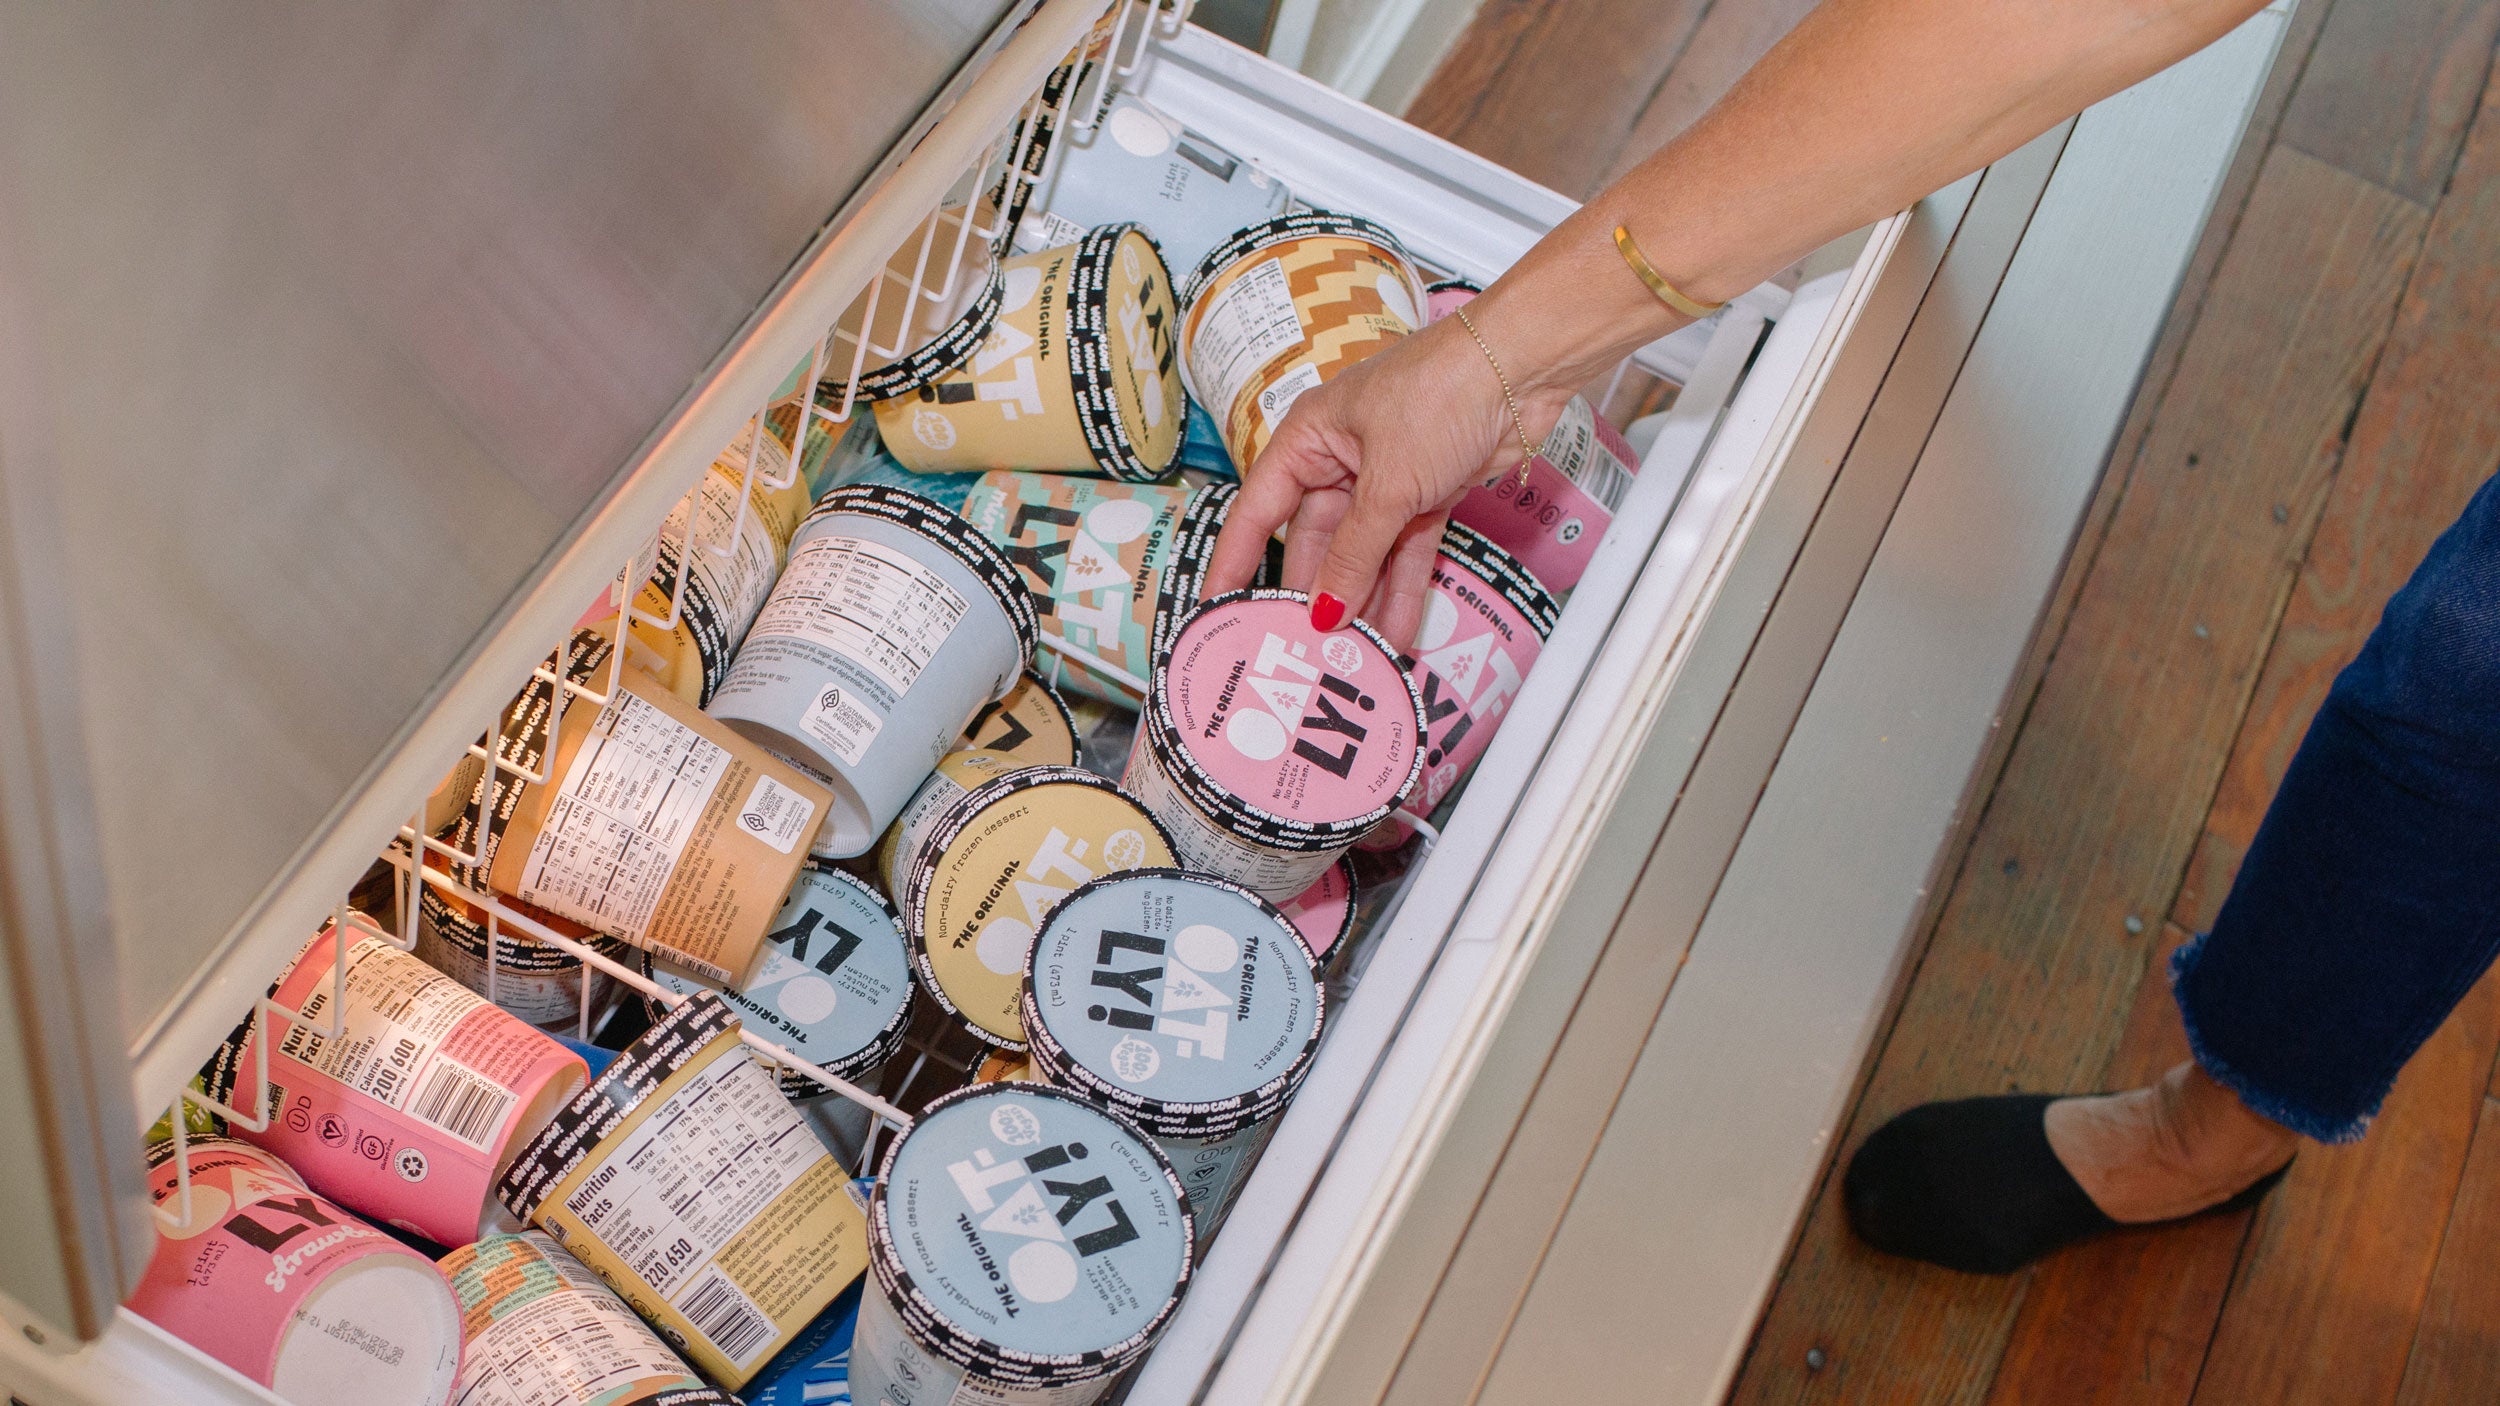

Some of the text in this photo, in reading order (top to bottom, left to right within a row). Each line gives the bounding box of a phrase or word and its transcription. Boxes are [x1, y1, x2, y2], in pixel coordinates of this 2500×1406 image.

[1164, 162, 1180, 196] pint
[1038, 257, 1064, 362] THE ORIGINAL
[1565, 426, 1586, 477] 200 600
[885, 492, 952, 525] WOW NO COW!
[852, 556, 867, 564] Total
[1133, 504, 1177, 602] THE ORIGINAL
[1483, 552, 1538, 601] WOW NO COW!
[824, 601, 842, 613] Protein
[1455, 585, 1513, 642] ORIGINAL
[1179, 617, 1241, 730] Non-dairy frozen dessert
[1204, 659, 1246, 738] THE ORIGINAL
[521, 697, 550, 741] NO COW!
[815, 715, 856, 749] Certified Sourcing
[831, 712, 861, 736] INITIATIVE
[835, 706, 863, 729] FORESTRY
[839, 701, 876, 733] SUSTAINABLE
[1292, 673, 1375, 780] LY!
[1367, 721, 1403, 794] 1 pint (473 ml)
[580, 769, 601, 801] Total Carb.
[1272, 759, 1290, 799] No dairy.
[1283, 765, 1299, 800] No nuts.
[1291, 764, 1310, 810] No gluten.
[754, 780, 776, 813] SUSTAINABLE
[760, 791, 778, 816] FORESTRY
[767, 795, 785, 820] INITIATIVE
[637, 809, 652, 831] Protein
[1243, 803, 1314, 832] WOW NO COW!
[938, 805, 1030, 938] Non-dairy frozen dessert
[850, 899, 873, 918] pint
[952, 860, 1020, 950] THE ORIGINAL
[845, 965, 891, 993] No gluten.
[1049, 926, 1077, 1007] 1 pint (473 ml)
[1087, 929, 1166, 1031] LY!
[1237, 936, 1259, 1022] THE ORIGINAL
[837, 980, 878, 1006] No dairy.
[1254, 941, 1300, 1071] Non-dairy frozen dessert
[722, 986, 807, 1043] THE ORIGINAL
[335, 1039, 362, 1080] Serving size
[344, 1071, 356, 1084] 2/3
[350, 1058, 364, 1073] cup
[358, 1055, 386, 1093] Calories
[370, 1036, 417, 1101] 200 600
[447, 1061, 502, 1097] 90646 63018
[1162, 1096, 1242, 1114] WOW NO COW!
[351, 1128, 364, 1154] Certified
[364, 1140, 379, 1156] GF
[379, 1137, 396, 1170] Gluten-Free
[630, 1148, 655, 1172] Total Fat
[564, 1161, 622, 1216] Nutrition
[657, 1171, 690, 1202] Cholesterol
[1023, 1141, 1140, 1258] LY!
[1150, 1188, 1169, 1217] pint
[580, 1195, 616, 1229] Facts
[192, 1237, 219, 1275] pint
[612, 1224, 641, 1254] Serving size
[907, 1179, 998, 1325] Non-dairy frozen dessert
[631, 1246, 661, 1274] Calories
[641, 1236, 694, 1289] 220 650
[806, 1242, 840, 1275] www.oatly.com
[956, 1212, 1020, 1319] THE ORIGINAL
[749, 1270, 777, 1298] Distributed
[718, 1277, 765, 1326] 90646 63016
[999, 1348, 1083, 1366] WOW NO COW!
